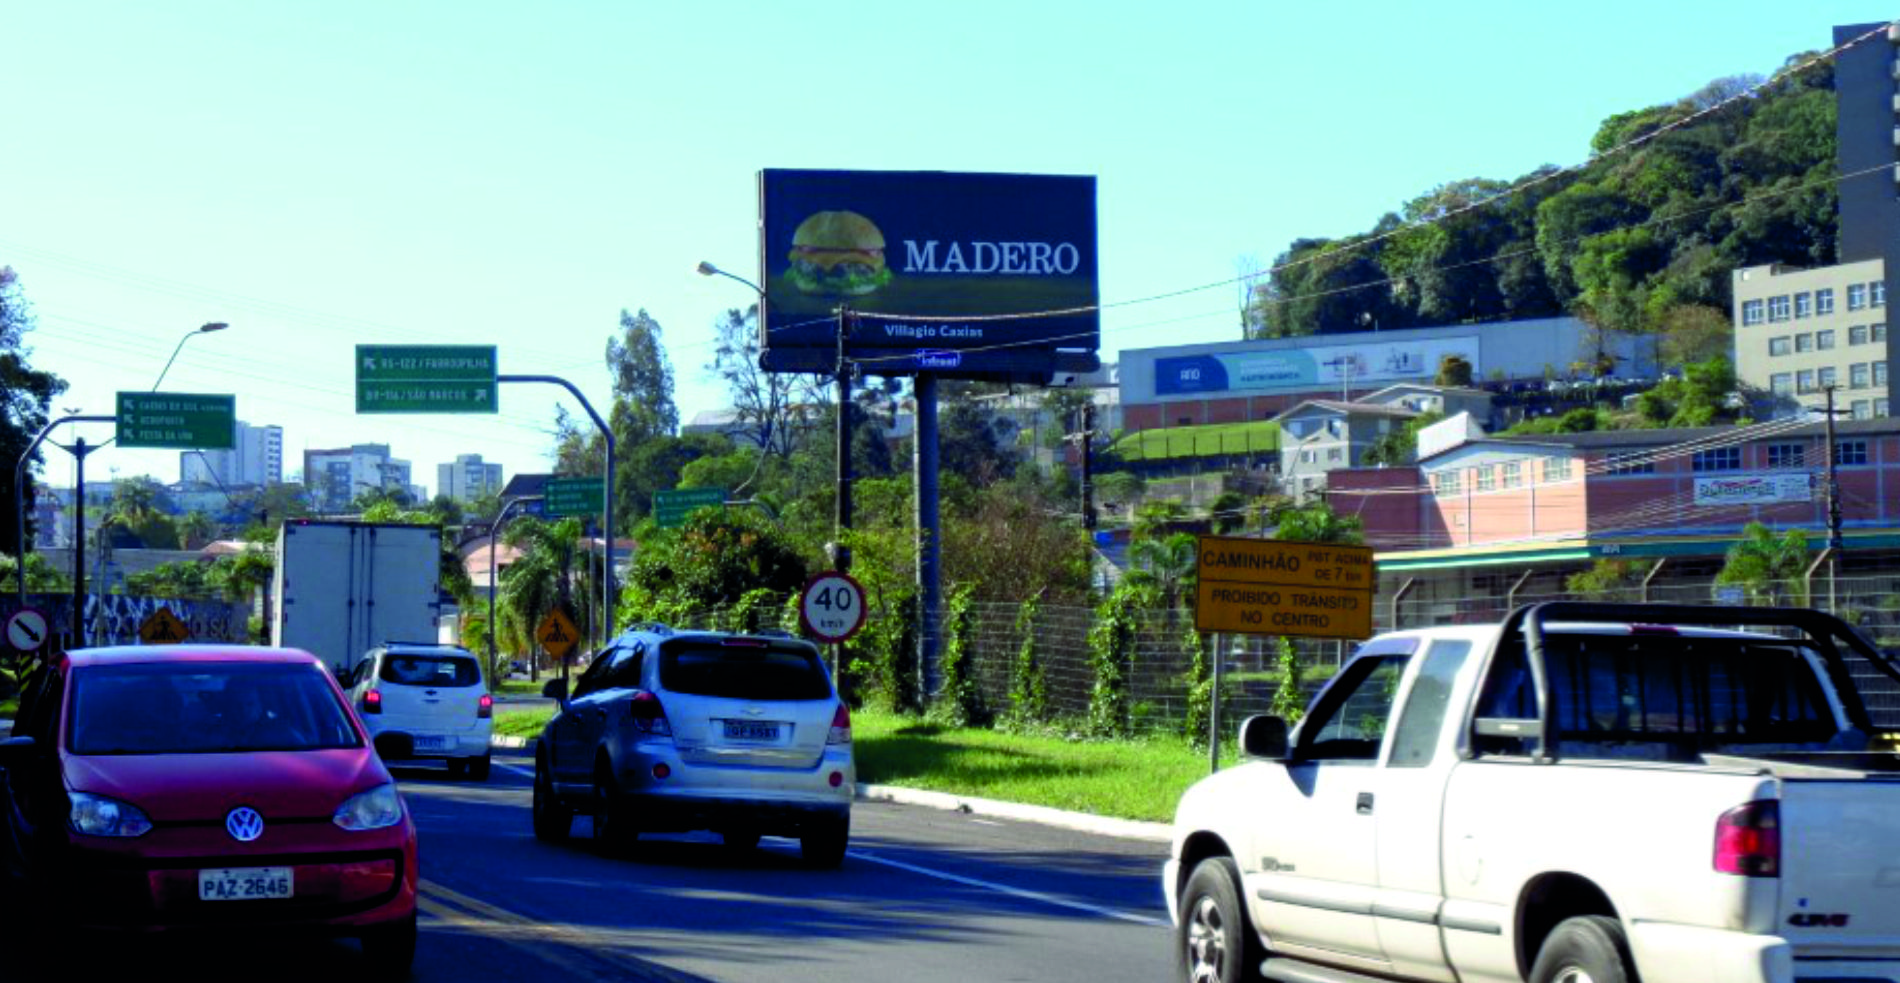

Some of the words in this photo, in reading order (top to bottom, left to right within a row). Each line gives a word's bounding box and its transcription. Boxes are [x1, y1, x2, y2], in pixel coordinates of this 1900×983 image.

[903, 240, 1080, 274] MADERO
[884, 325, 935, 339] Villagio
[940, 325, 983, 337] Caxias
[1203, 550, 1300, 572] CAMINHÃO
[1335, 552, 1368, 565] ACIMA
[1315, 568, 1331, 580] DE
[1335, 567, 1343, 580] 7
[814, 586, 851, 611] 40
[1211, 588, 1281, 605] PROIBIDO
[1290, 591, 1359, 610] TRÂNSITO
[1241, 610, 1262, 624] NO
[1272, 612, 1330, 628] CENTRO
